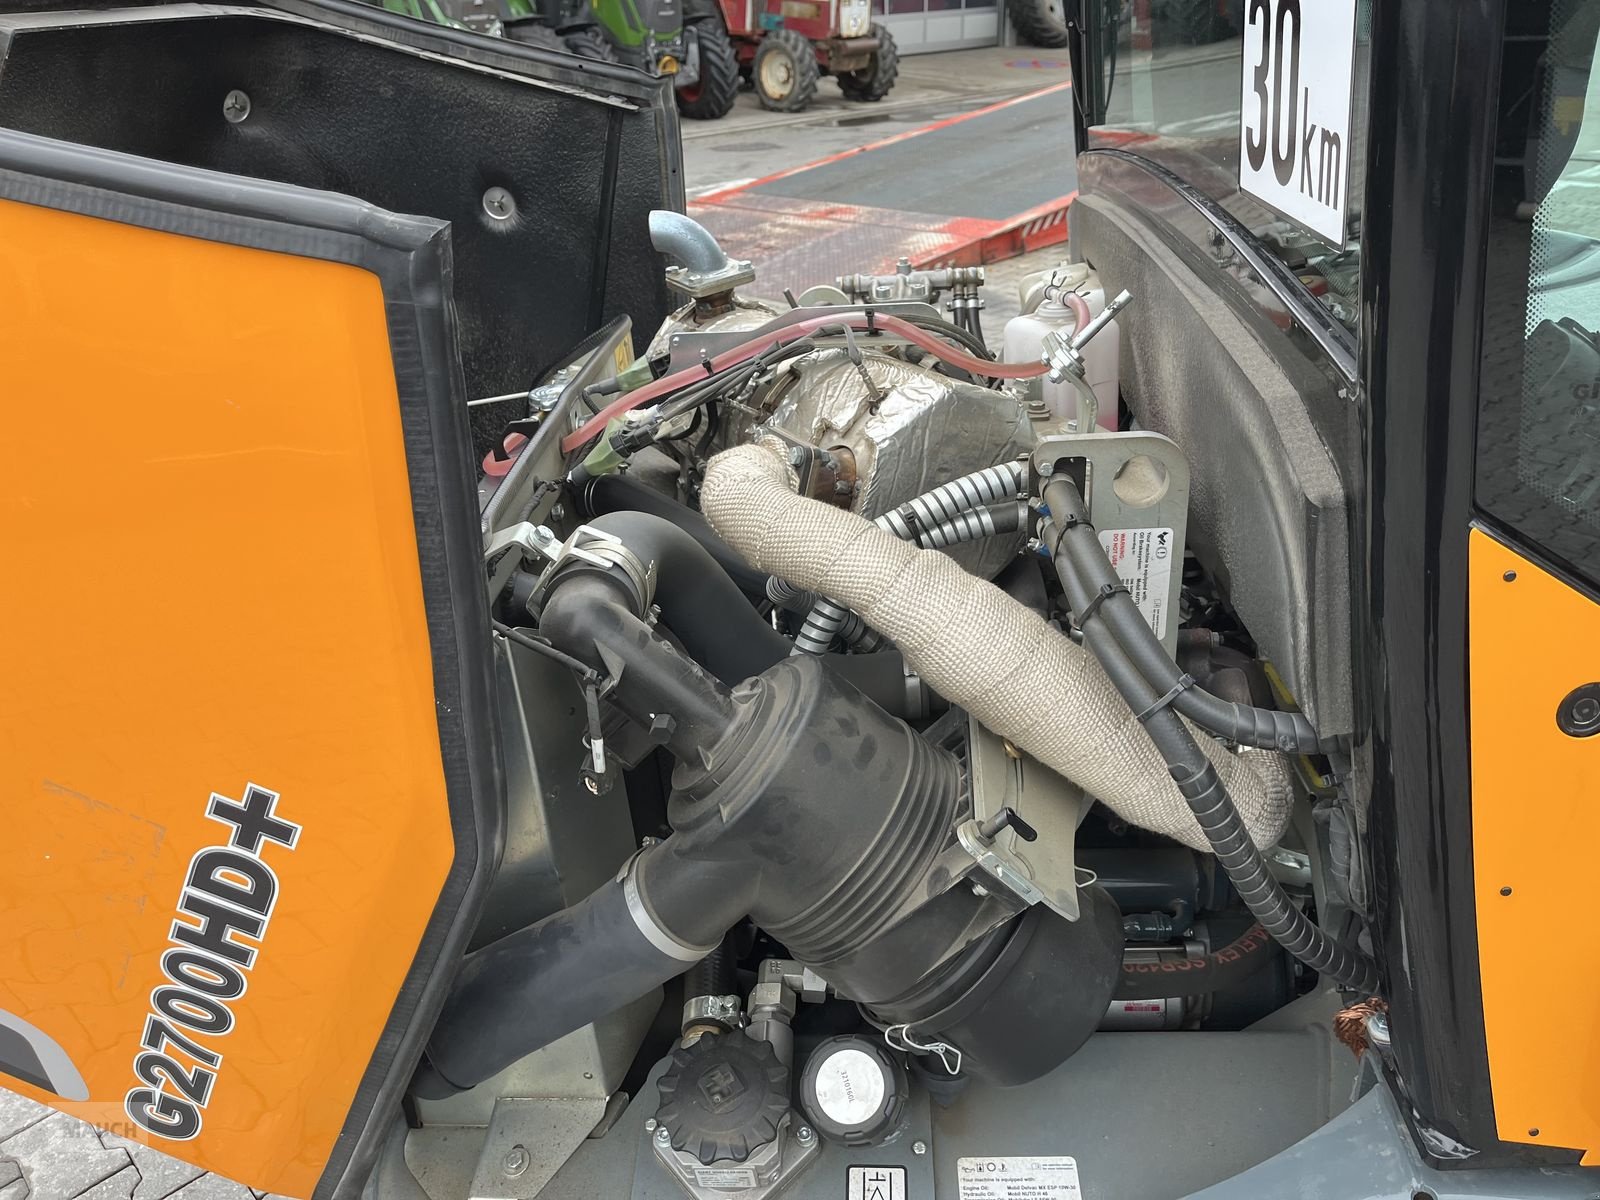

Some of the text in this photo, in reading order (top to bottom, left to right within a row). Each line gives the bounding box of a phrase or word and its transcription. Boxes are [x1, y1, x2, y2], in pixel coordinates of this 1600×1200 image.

[1246, 0, 1341, 211] 30 km
[125, 783, 302, 1140] G2700HD+
